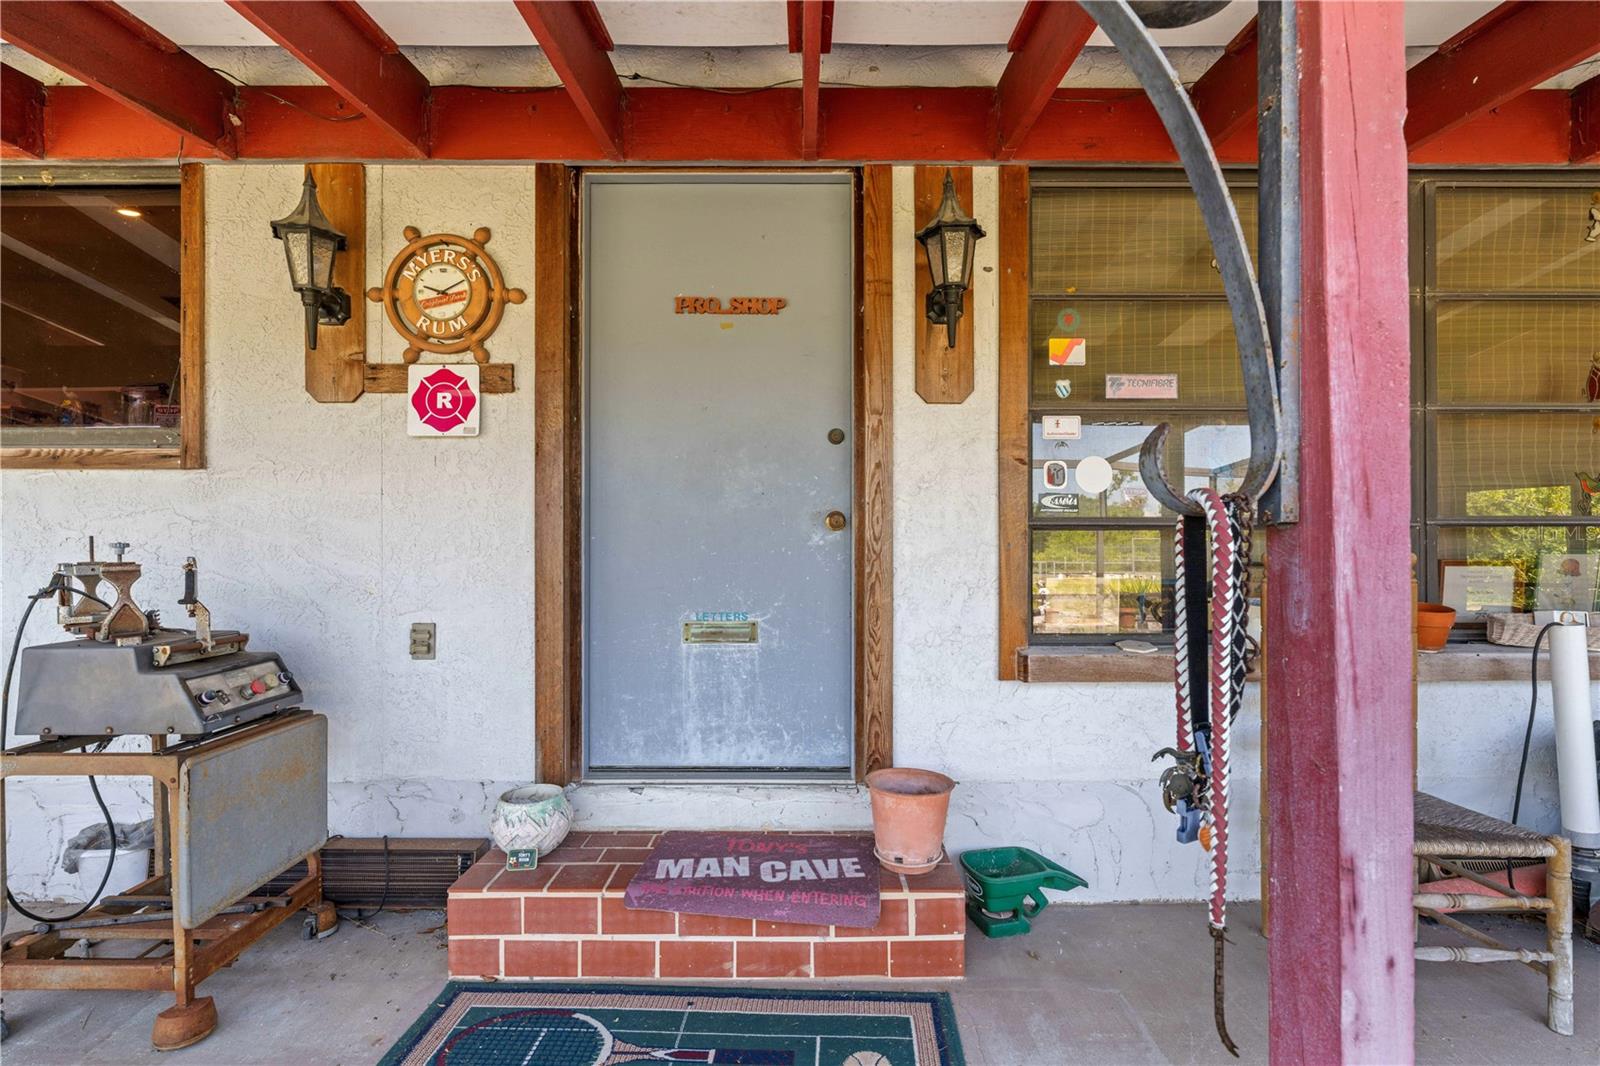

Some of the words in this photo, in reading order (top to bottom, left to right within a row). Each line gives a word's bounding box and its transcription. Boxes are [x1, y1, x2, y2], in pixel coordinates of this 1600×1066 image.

[403, 249, 481, 282] MYERS'S
[674, 296, 721, 314] PRO
[729, 296, 787, 314] SHOP
[416, 315, 468, 335] RUM
[436, 392, 453, 409] R
[695, 611, 749, 622] LETTERS
[655, 856, 750, 880] MAN
[760, 857, 866, 883] CAVE
[741, 888, 785, 903] WHEN
[790, 888, 868, 908] ENTERING
